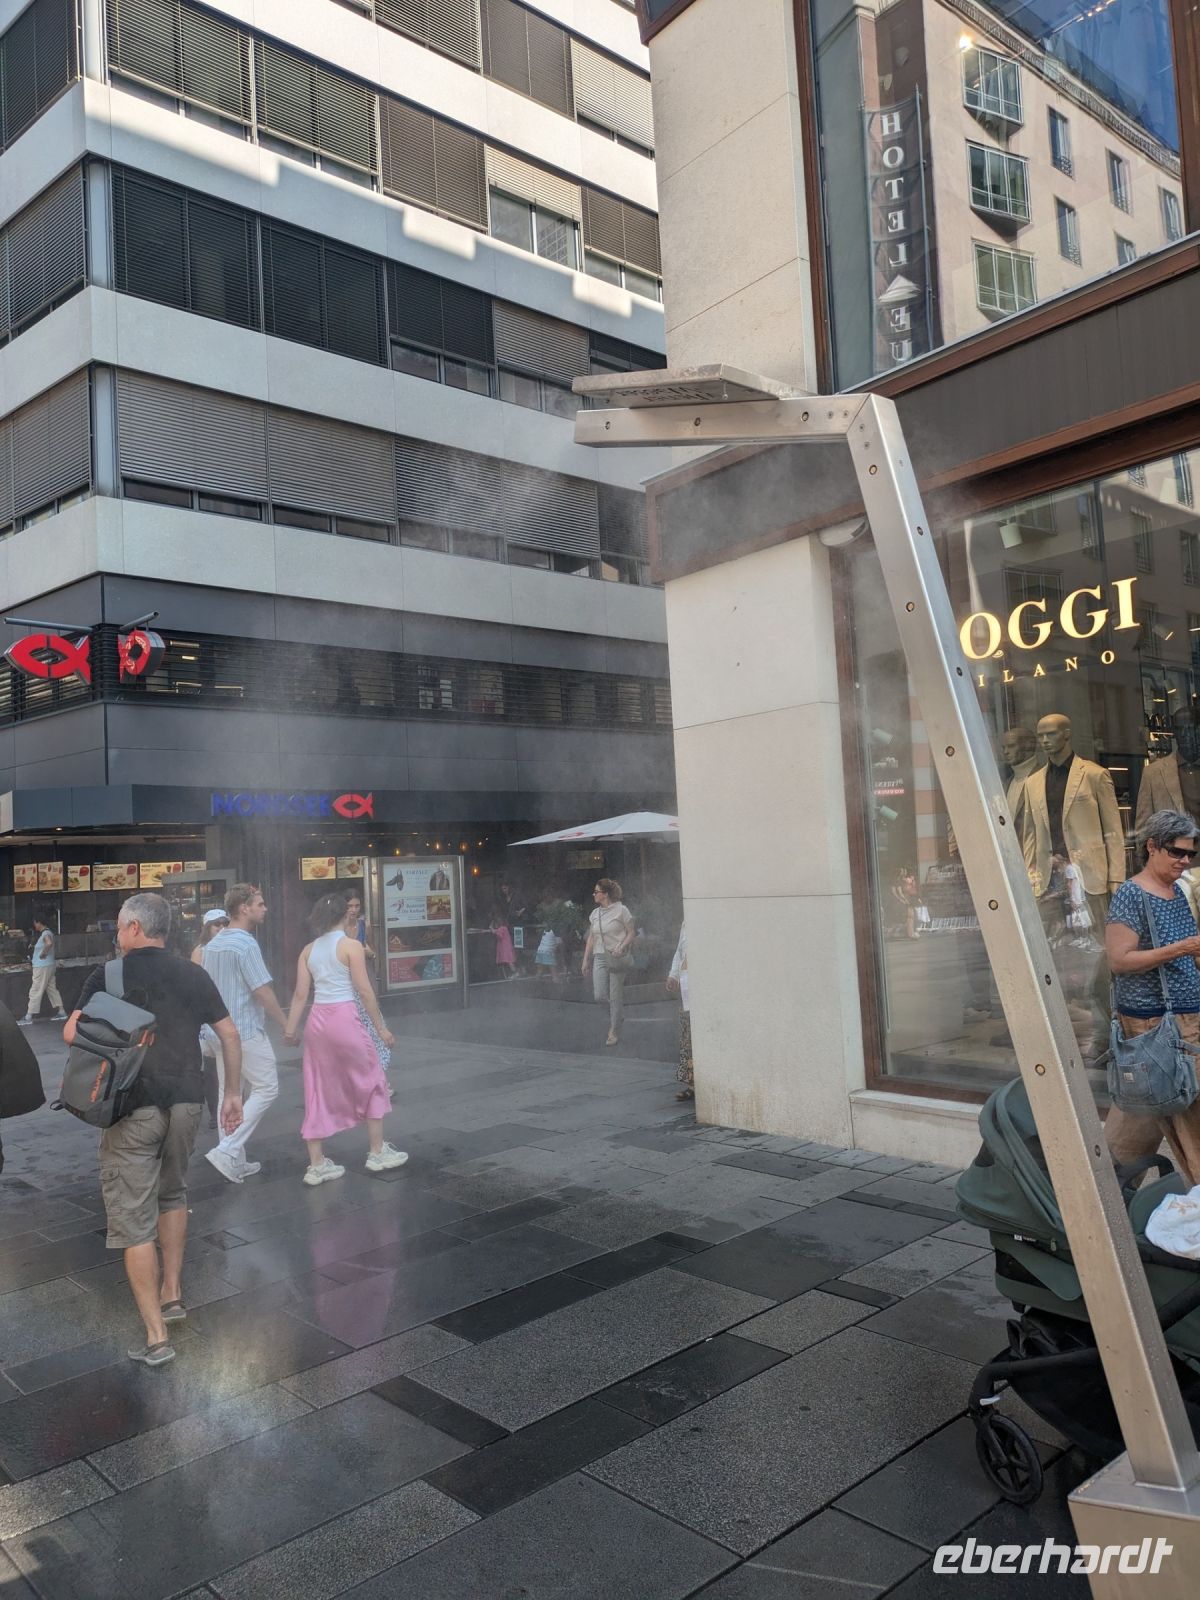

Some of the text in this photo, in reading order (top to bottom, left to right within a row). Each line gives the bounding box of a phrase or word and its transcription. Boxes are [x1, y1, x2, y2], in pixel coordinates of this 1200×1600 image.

[959, 576, 1142, 660] OGGI
[977, 649, 1116, 688] ILANO
[210, 791, 332, 818] NORDSEE
